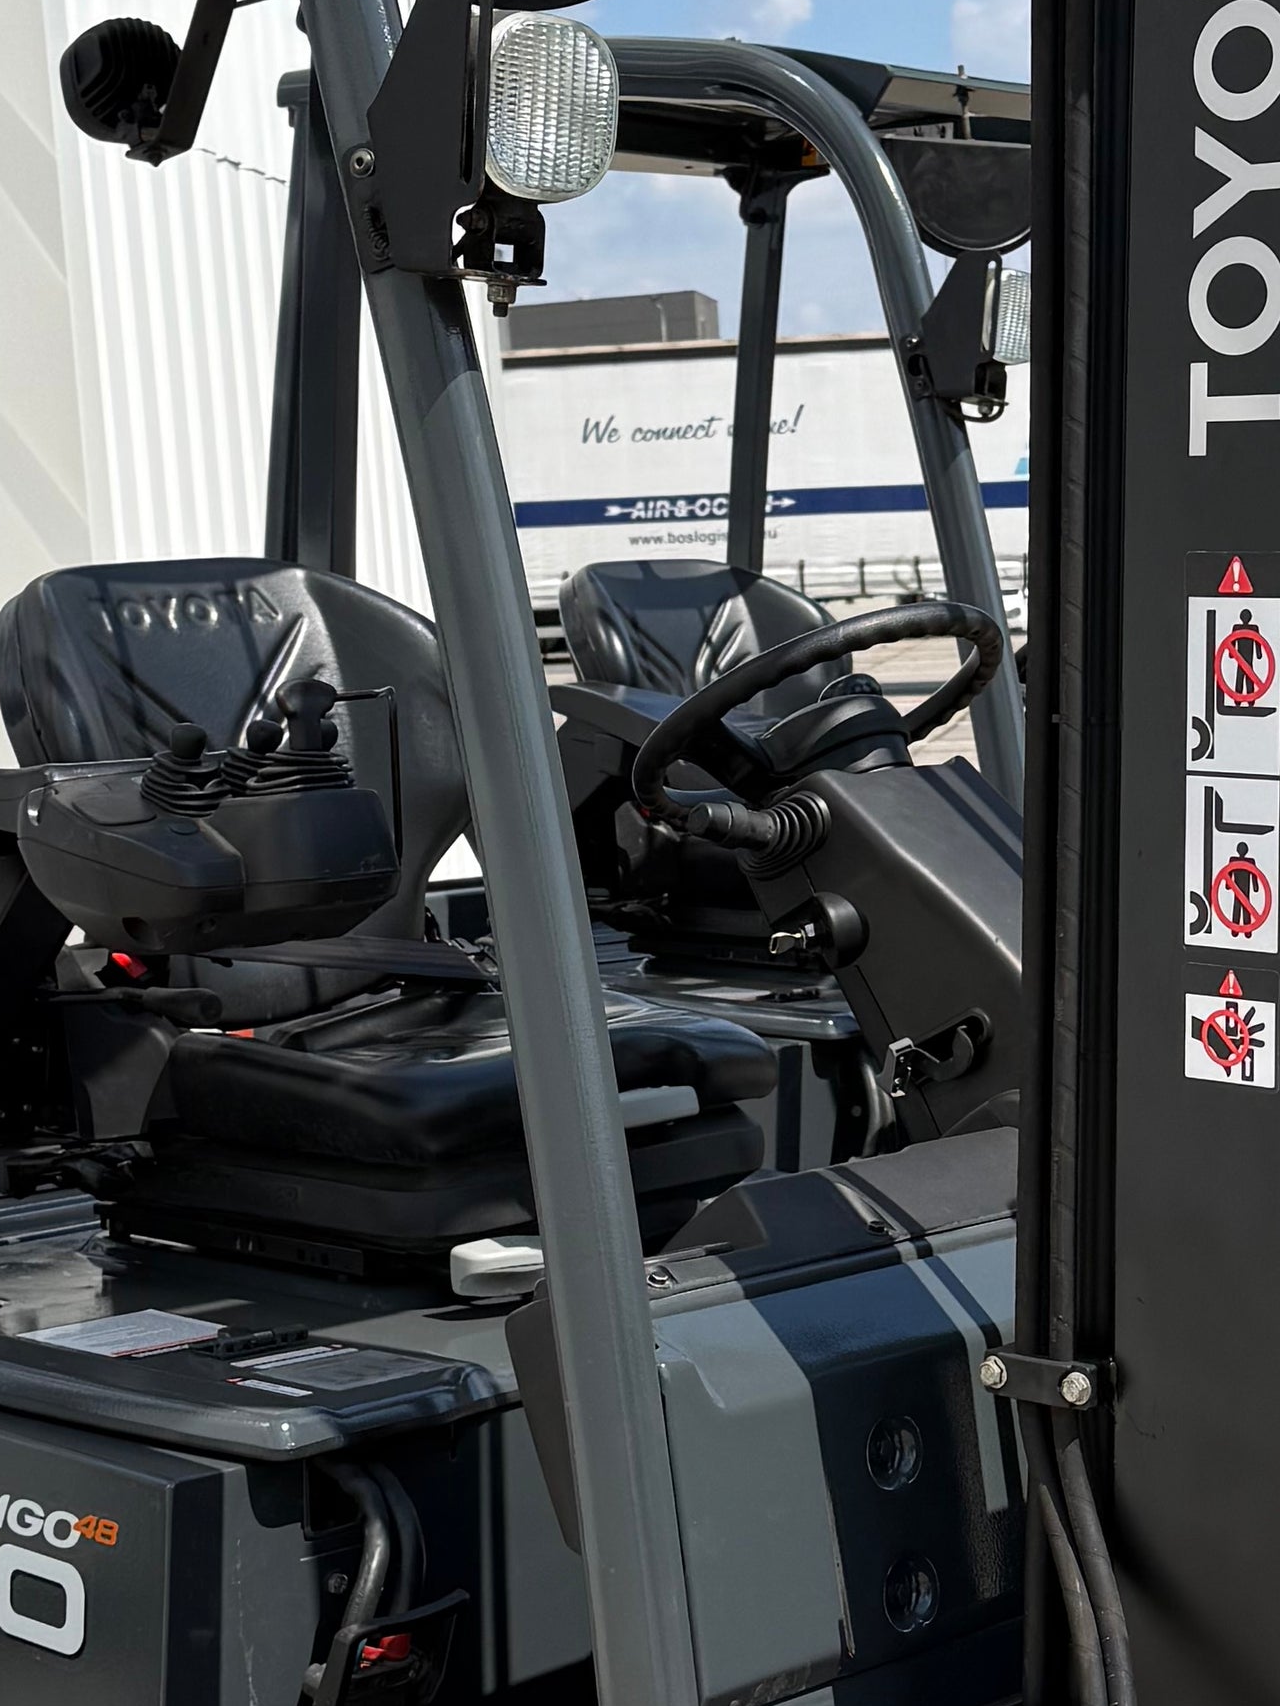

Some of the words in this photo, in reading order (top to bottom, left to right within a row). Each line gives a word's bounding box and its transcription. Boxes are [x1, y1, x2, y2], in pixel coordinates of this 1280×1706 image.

[581, 414, 621, 444] We
[631, 415, 725, 443] connect
[88, 585, 283, 635] TOYOTA
